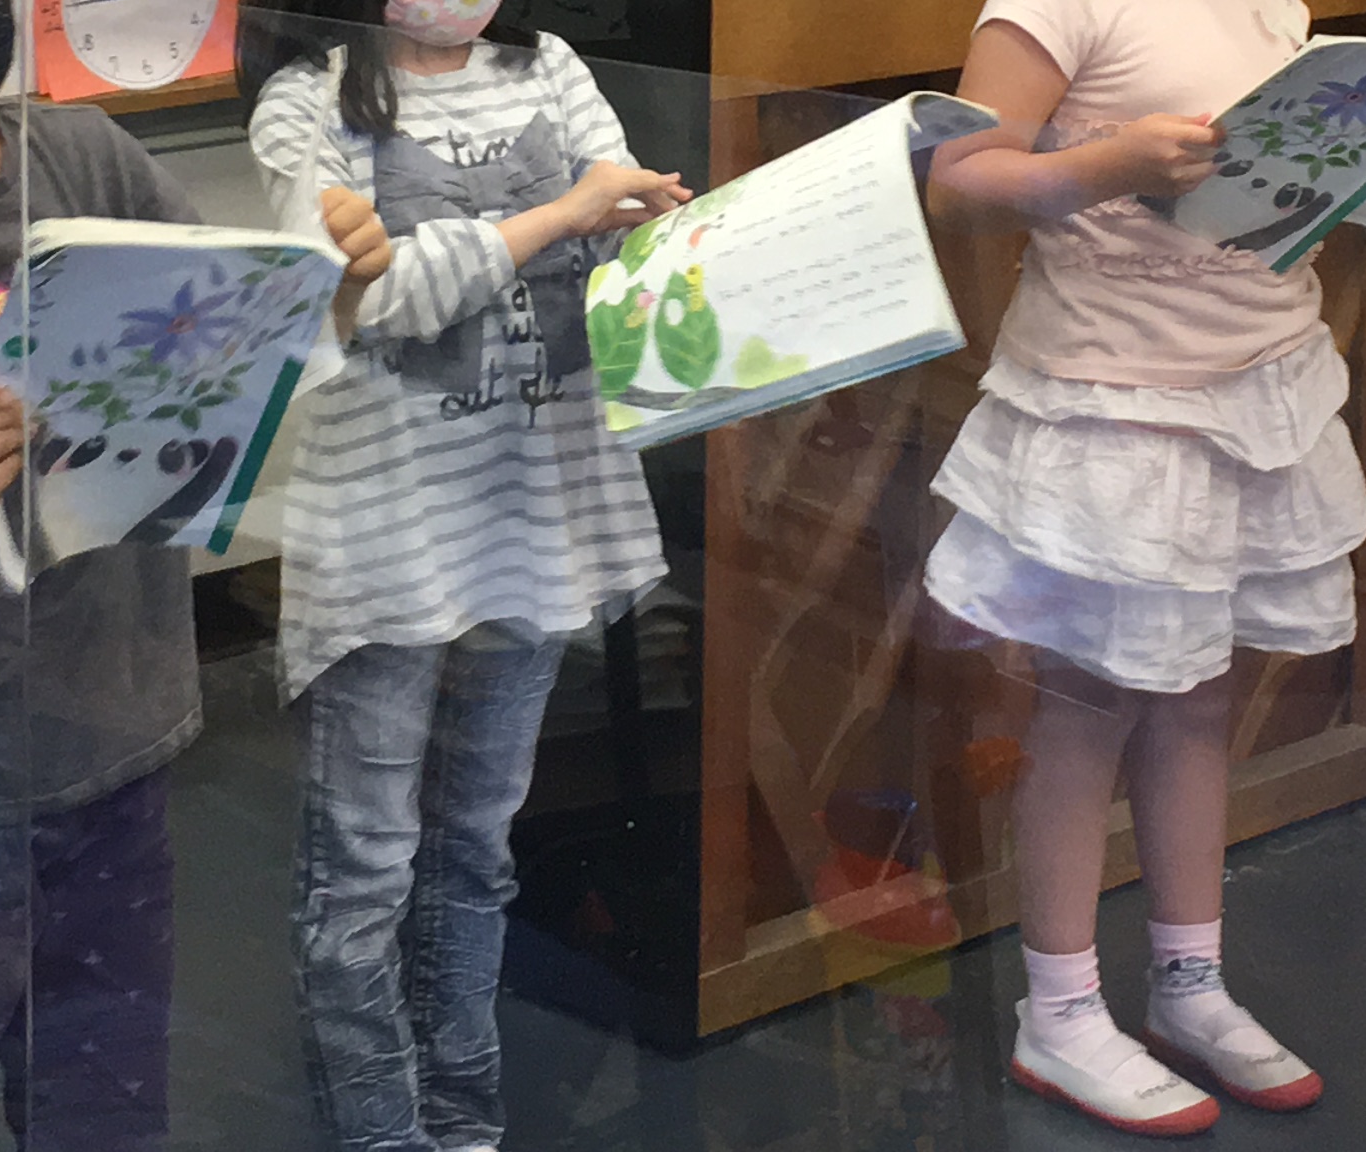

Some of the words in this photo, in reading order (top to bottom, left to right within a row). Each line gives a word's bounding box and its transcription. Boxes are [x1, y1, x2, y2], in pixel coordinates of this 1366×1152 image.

[190, 12, 201, 25] 4
[169, 41, 179, 59] 5
[109, 56, 120, 74] 7
[142, 59, 153, 75] 6
